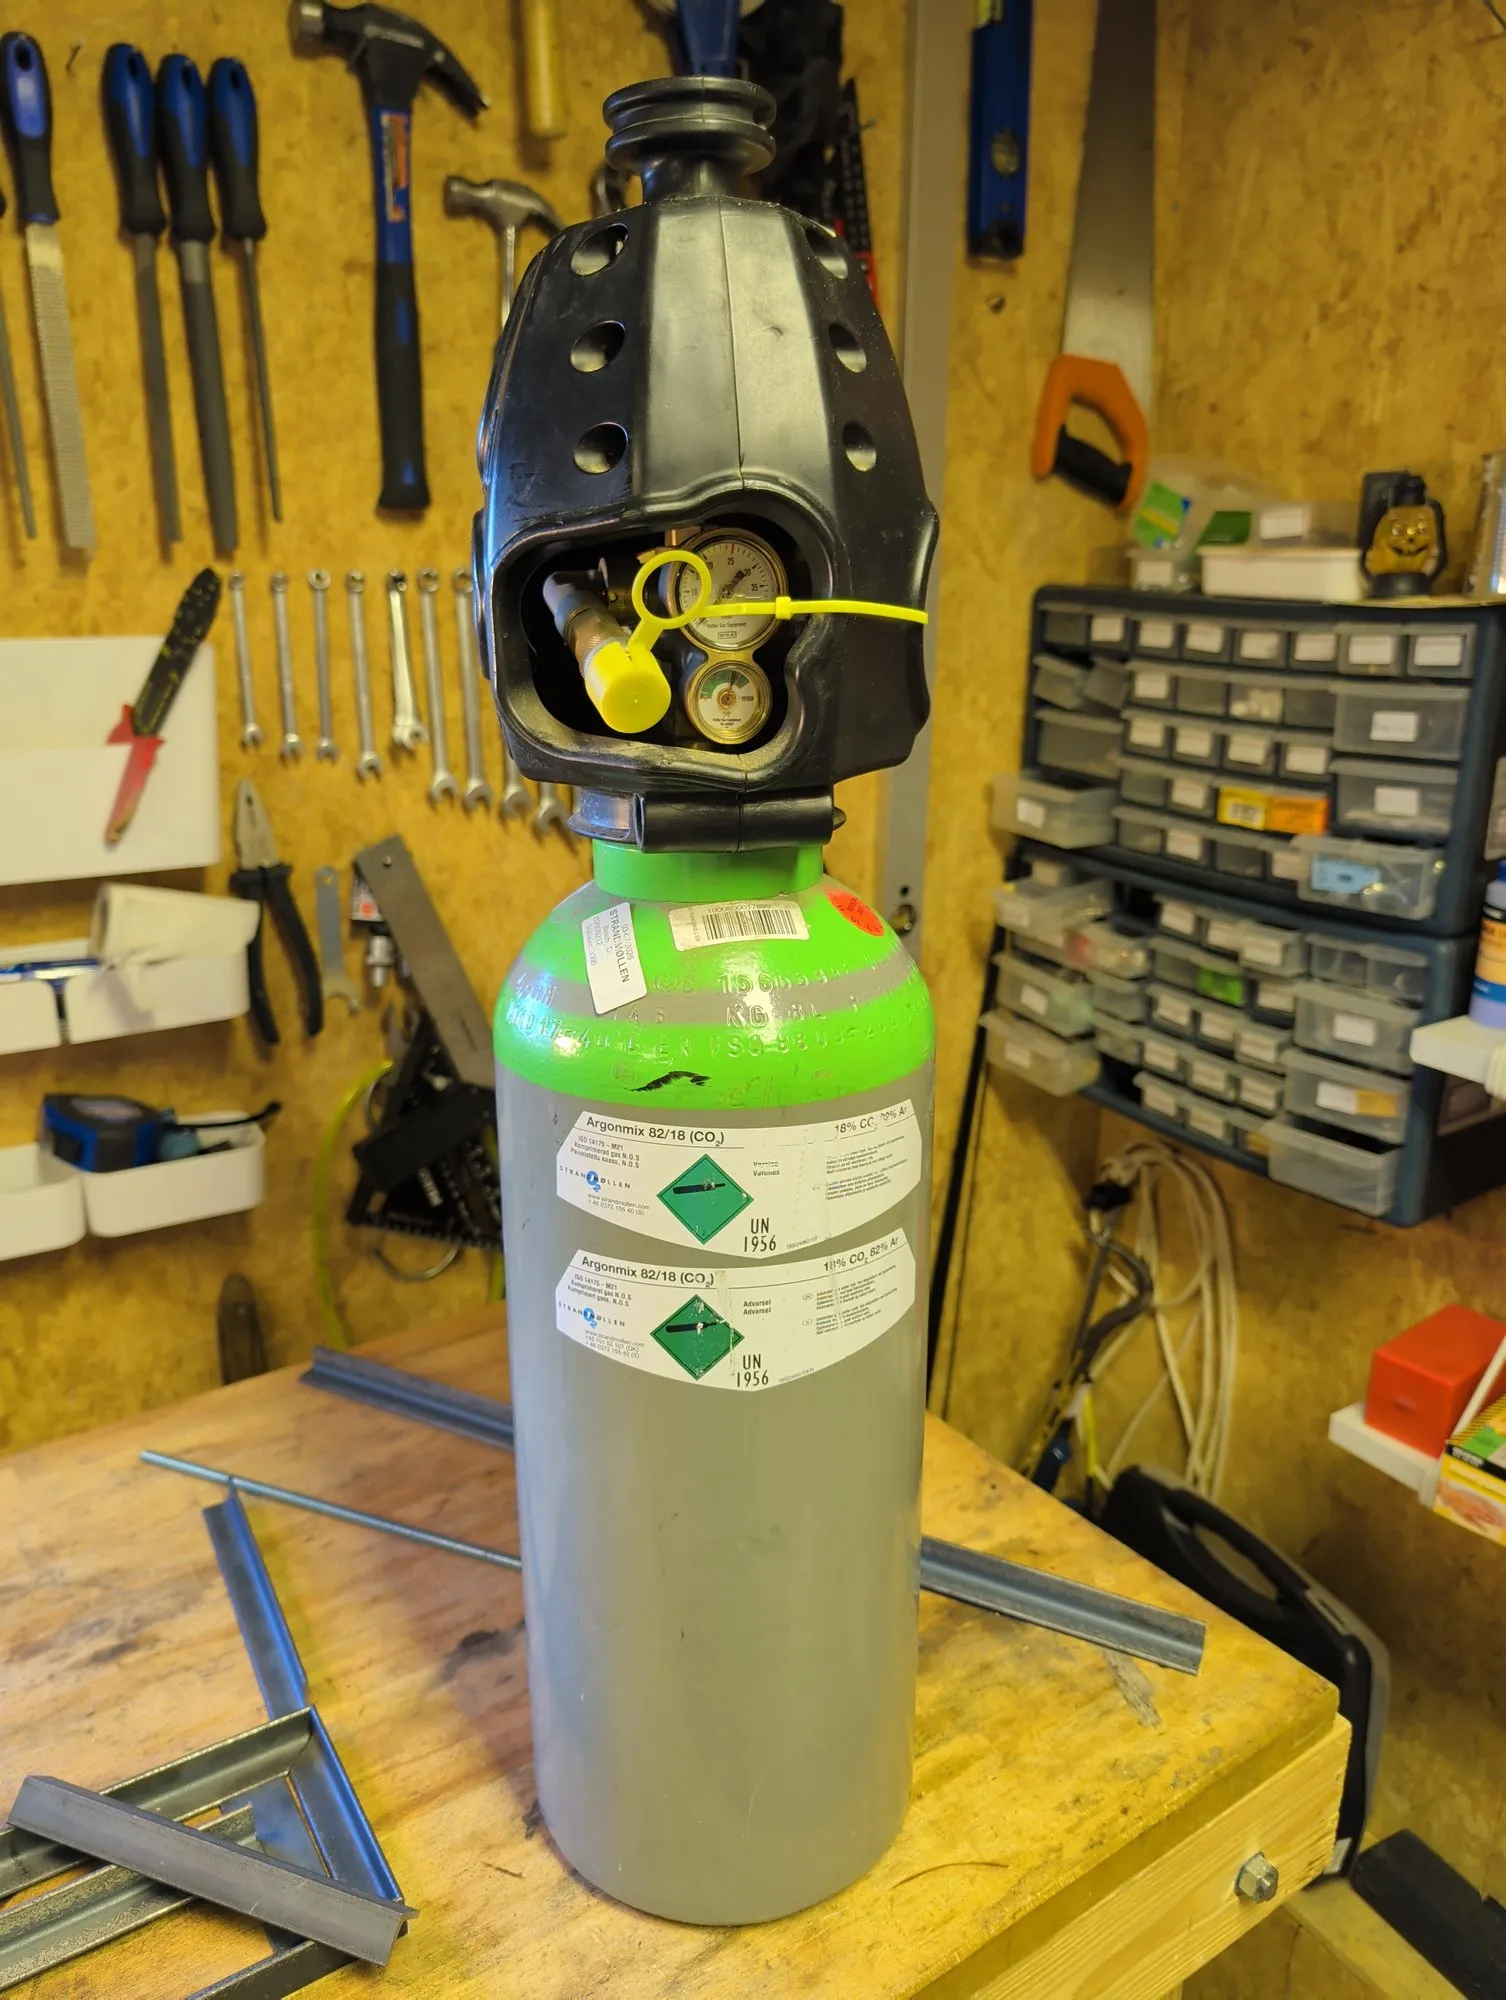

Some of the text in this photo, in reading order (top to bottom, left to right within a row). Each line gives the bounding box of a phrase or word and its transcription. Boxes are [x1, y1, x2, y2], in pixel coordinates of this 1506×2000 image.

[587, 1116, 645, 1137] Argonmix
[648, 1127, 686, 1142] 82/18
[834, 1122, 857, 1133] 18%
[880, 1108, 897, 1121] 2%
[750, 1217, 770, 1234] UN
[744, 1235, 776, 1252] 1956
[870, 1244, 889, 1257] 82%
[890, 1236, 899, 1247] Ar
[582, 1256, 637, 1278] Argonmix
[640, 1268, 676, 1282] 82/18
[743, 1299, 772, 1307] Advarsel
[742, 1354, 761, 1370] UN
[737, 1370, 769, 1387] 1956
